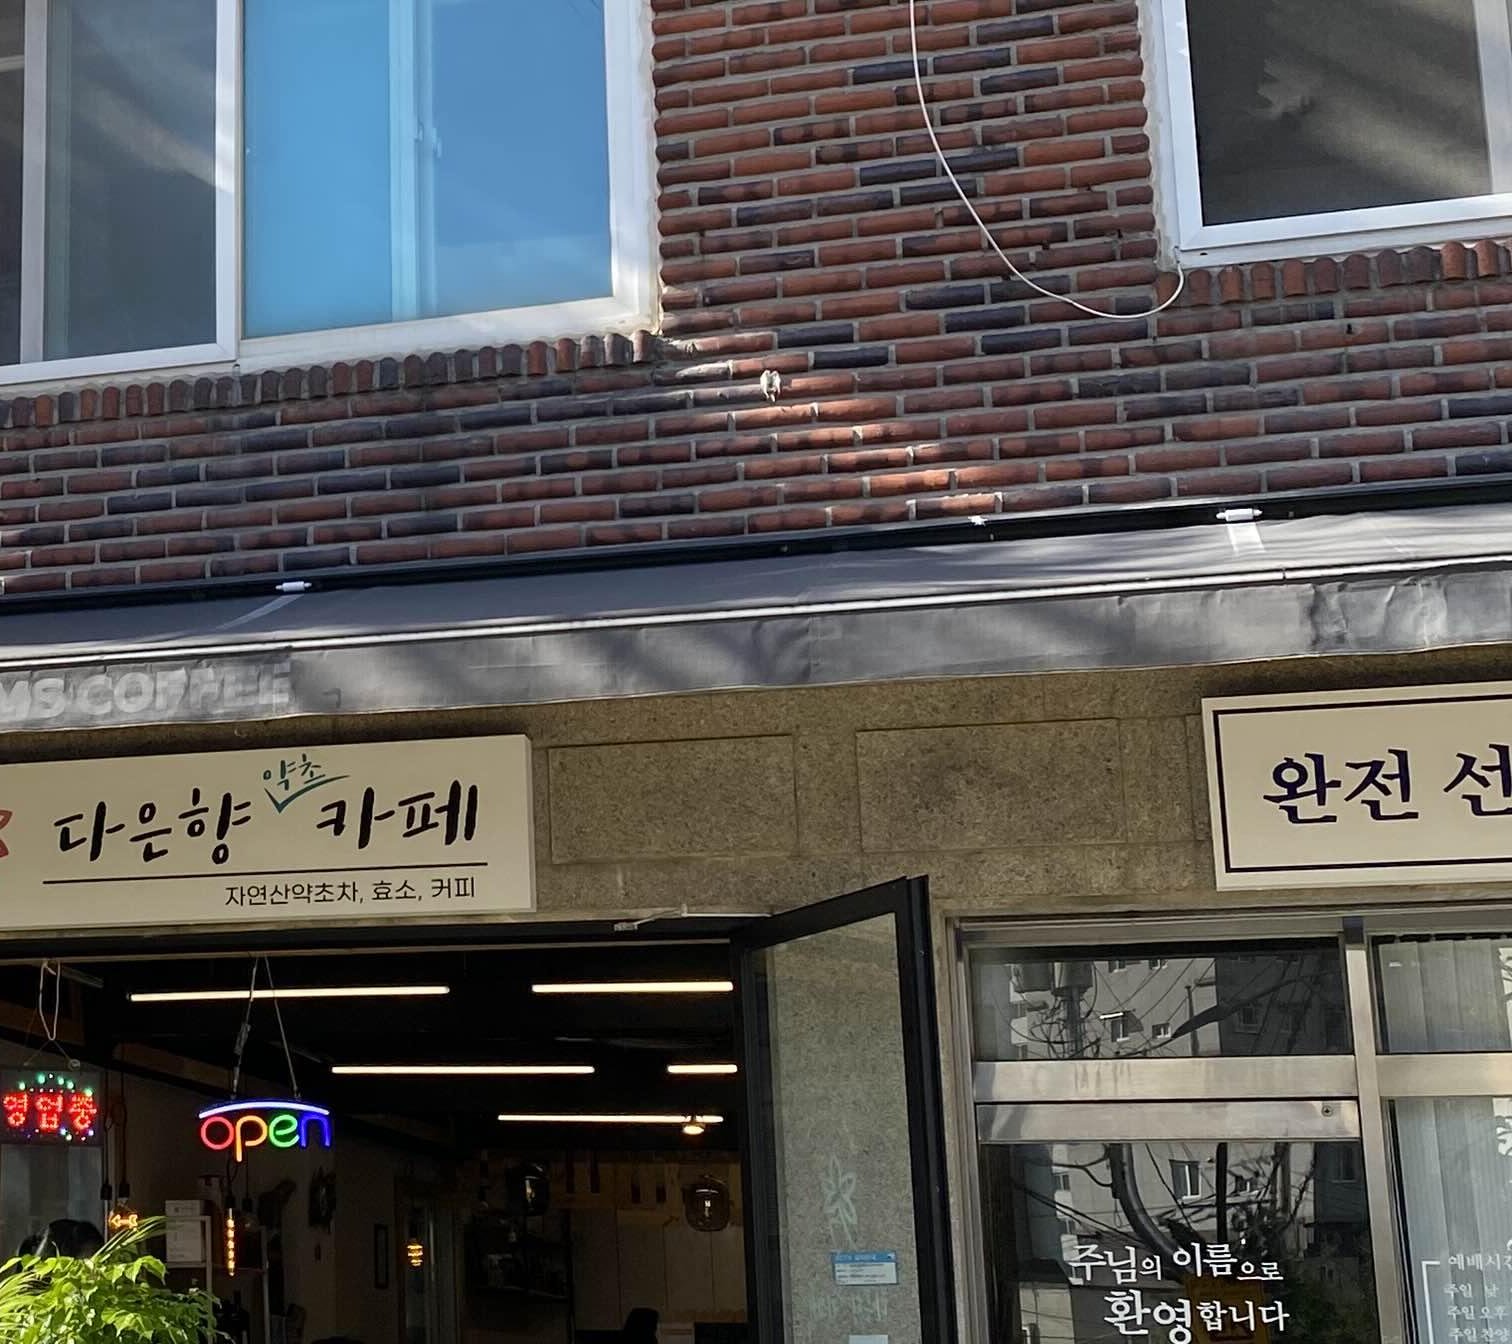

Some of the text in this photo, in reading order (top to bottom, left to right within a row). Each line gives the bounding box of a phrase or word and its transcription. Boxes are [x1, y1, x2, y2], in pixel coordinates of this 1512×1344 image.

[262, 752, 326, 791] 약초
[1262, 747, 1420, 825] 완전
[53, 779, 478, 865] 다은향 카페
[430, 876, 476, 900] 커피
[2, 1091, 98, 1132] 영업중
[199, 1113, 331, 1163] open
[1068, 1241, 1284, 1285] 주님의 이름으로
